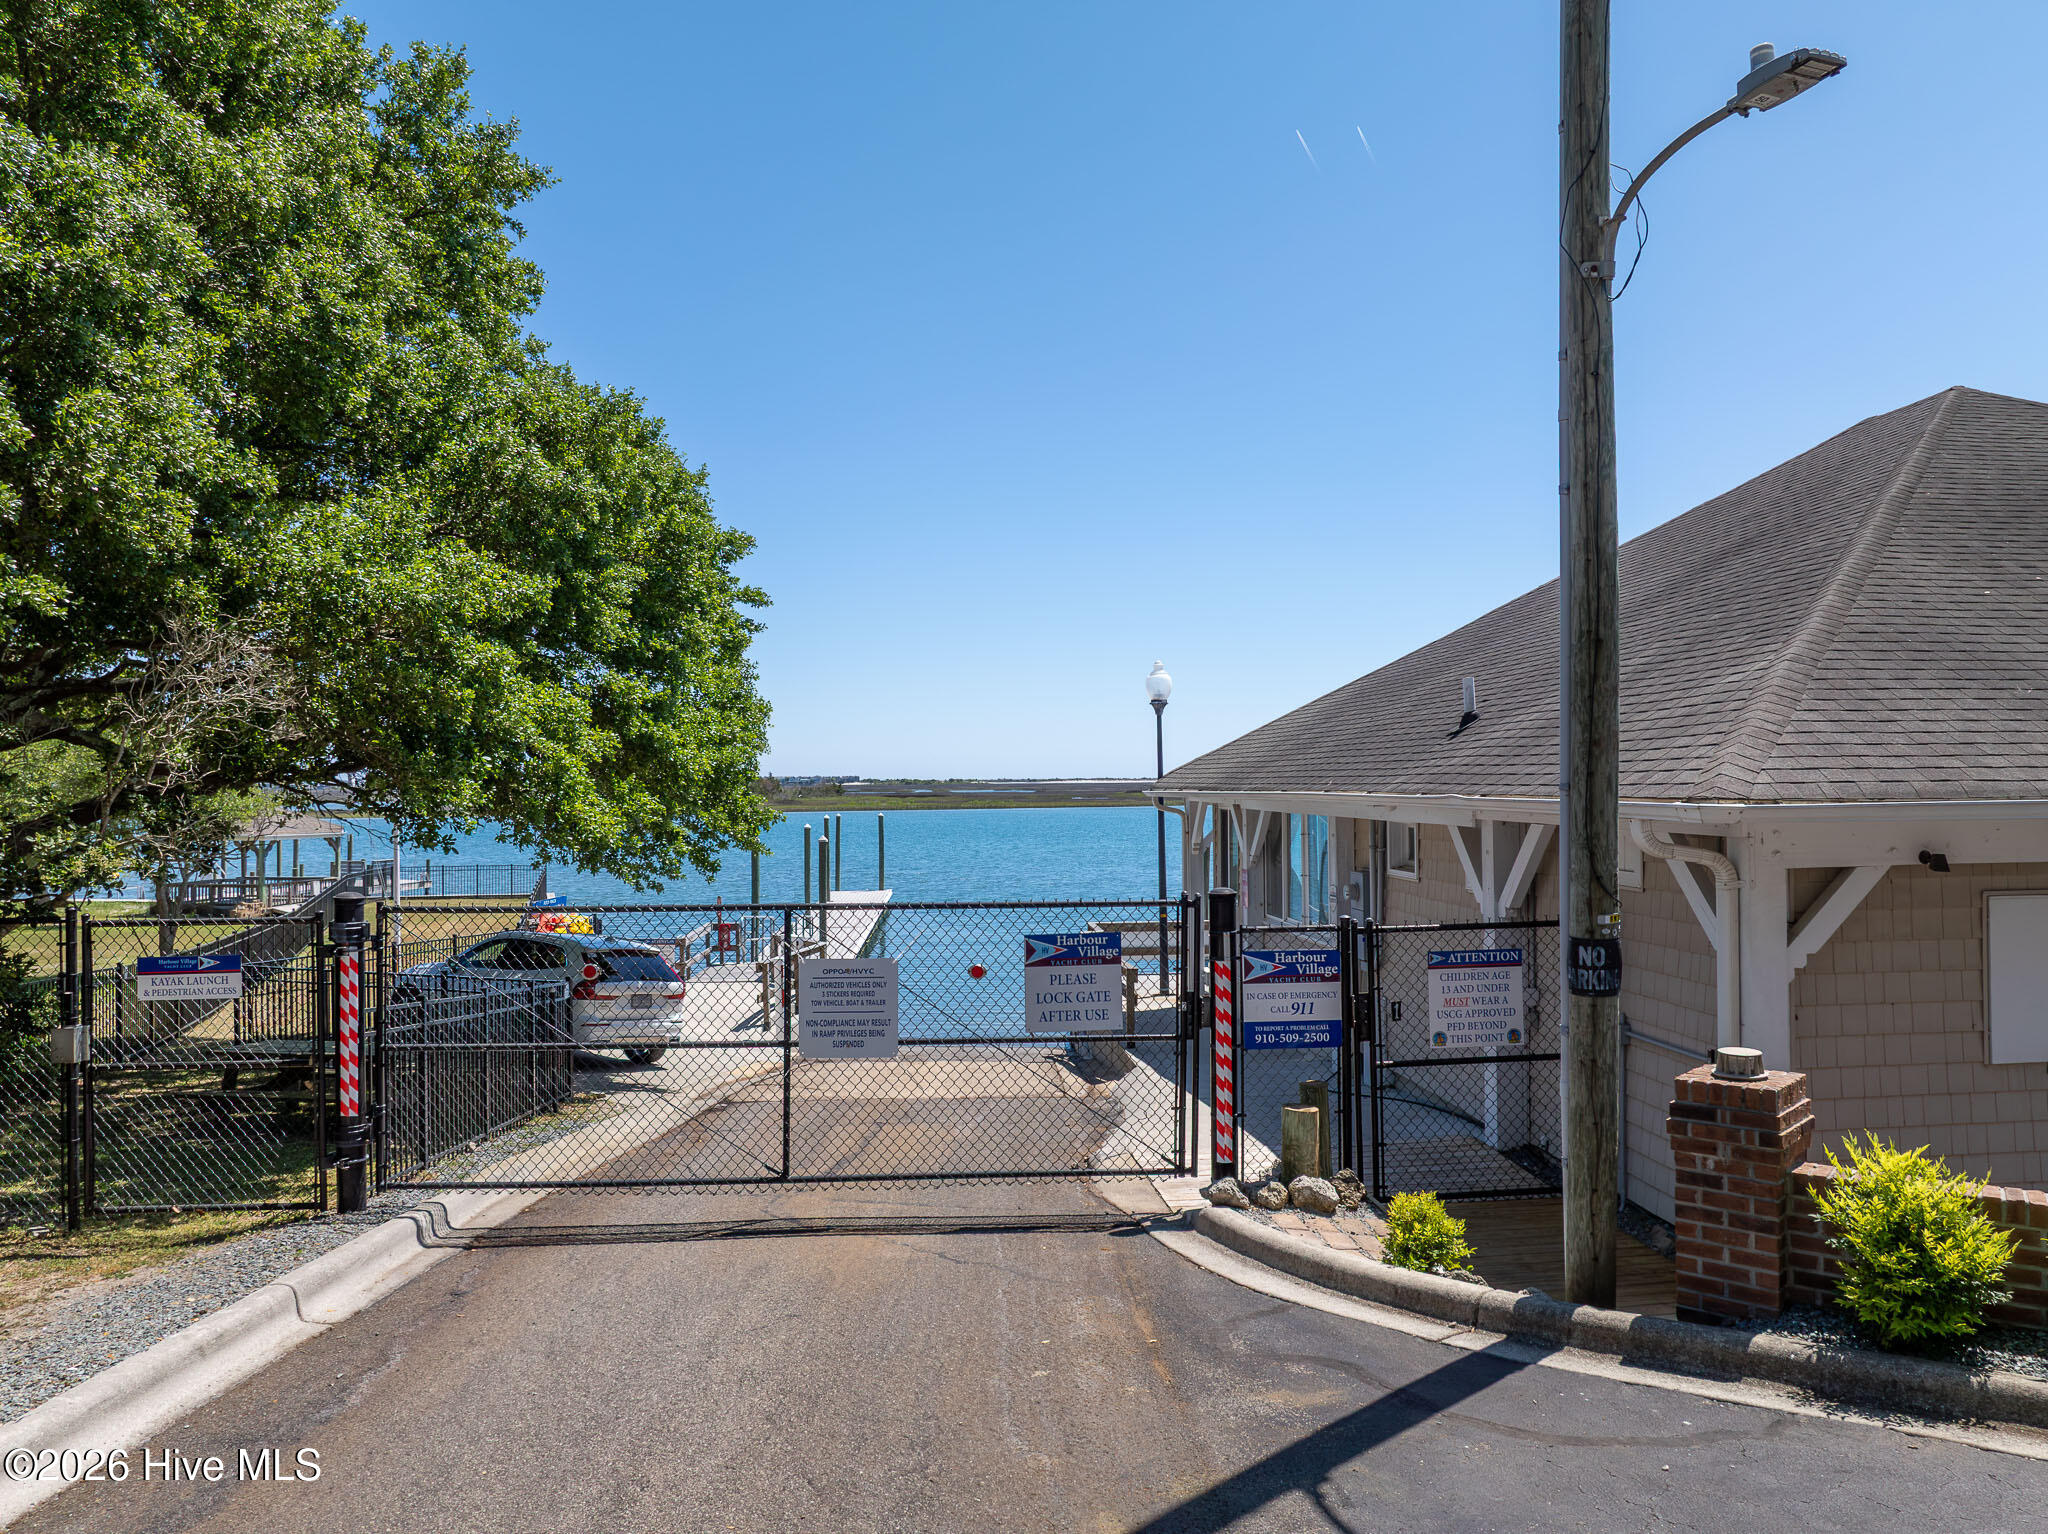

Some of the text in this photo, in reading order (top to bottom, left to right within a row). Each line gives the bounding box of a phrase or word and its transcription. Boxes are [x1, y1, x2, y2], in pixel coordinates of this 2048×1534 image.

[1057, 935, 1108, 946] Harbour
[1078, 946, 1120, 959] Village
[1274, 952, 1327, 964] Harbour
[1448, 951, 1519, 963] ATTENTION
[1578, 946, 1606, 967] NO
[1296, 964, 1338, 977] Village
[1440, 970, 1511, 982] CHILDREN AGE
[152, 976, 229, 986] KAYAK LAUNCH
[872, 980, 888, 988] ONLY
[1049, 973, 1097, 986] PLEASE
[144, 987, 237, 997] & PEDESTRIAN ACCESS
[850, 990, 876, 998] REQUIRED
[1441, 984, 1510, 994] 13 AND UNDER
[1036, 990, 1112, 1004] LOCK GATE
[1246, 991, 1338, 1001] IN CASE OF EMERGENCY
[1443, 996, 1509, 1008] MUST WEAR A
[1270, 1002, 1315, 1016] CALL 911
[1436, 1008, 1516, 1020] USCG APPROVED
[1039, 1009, 1110, 1022] AFTER USE
[806, 1018, 892, 1028] NON-COMPLIANCE MAY RESULT
[1446, 1020, 1508, 1032] PFD BEYOND
[811, 1030, 886, 1038] IN RAMP PRIVILEGES BEING
[1255, 1033, 1330, 1044] 910-509-2500
[1450, 1034, 1474, 1044] THIS
[1474, 1033, 1505, 1043] POINT
